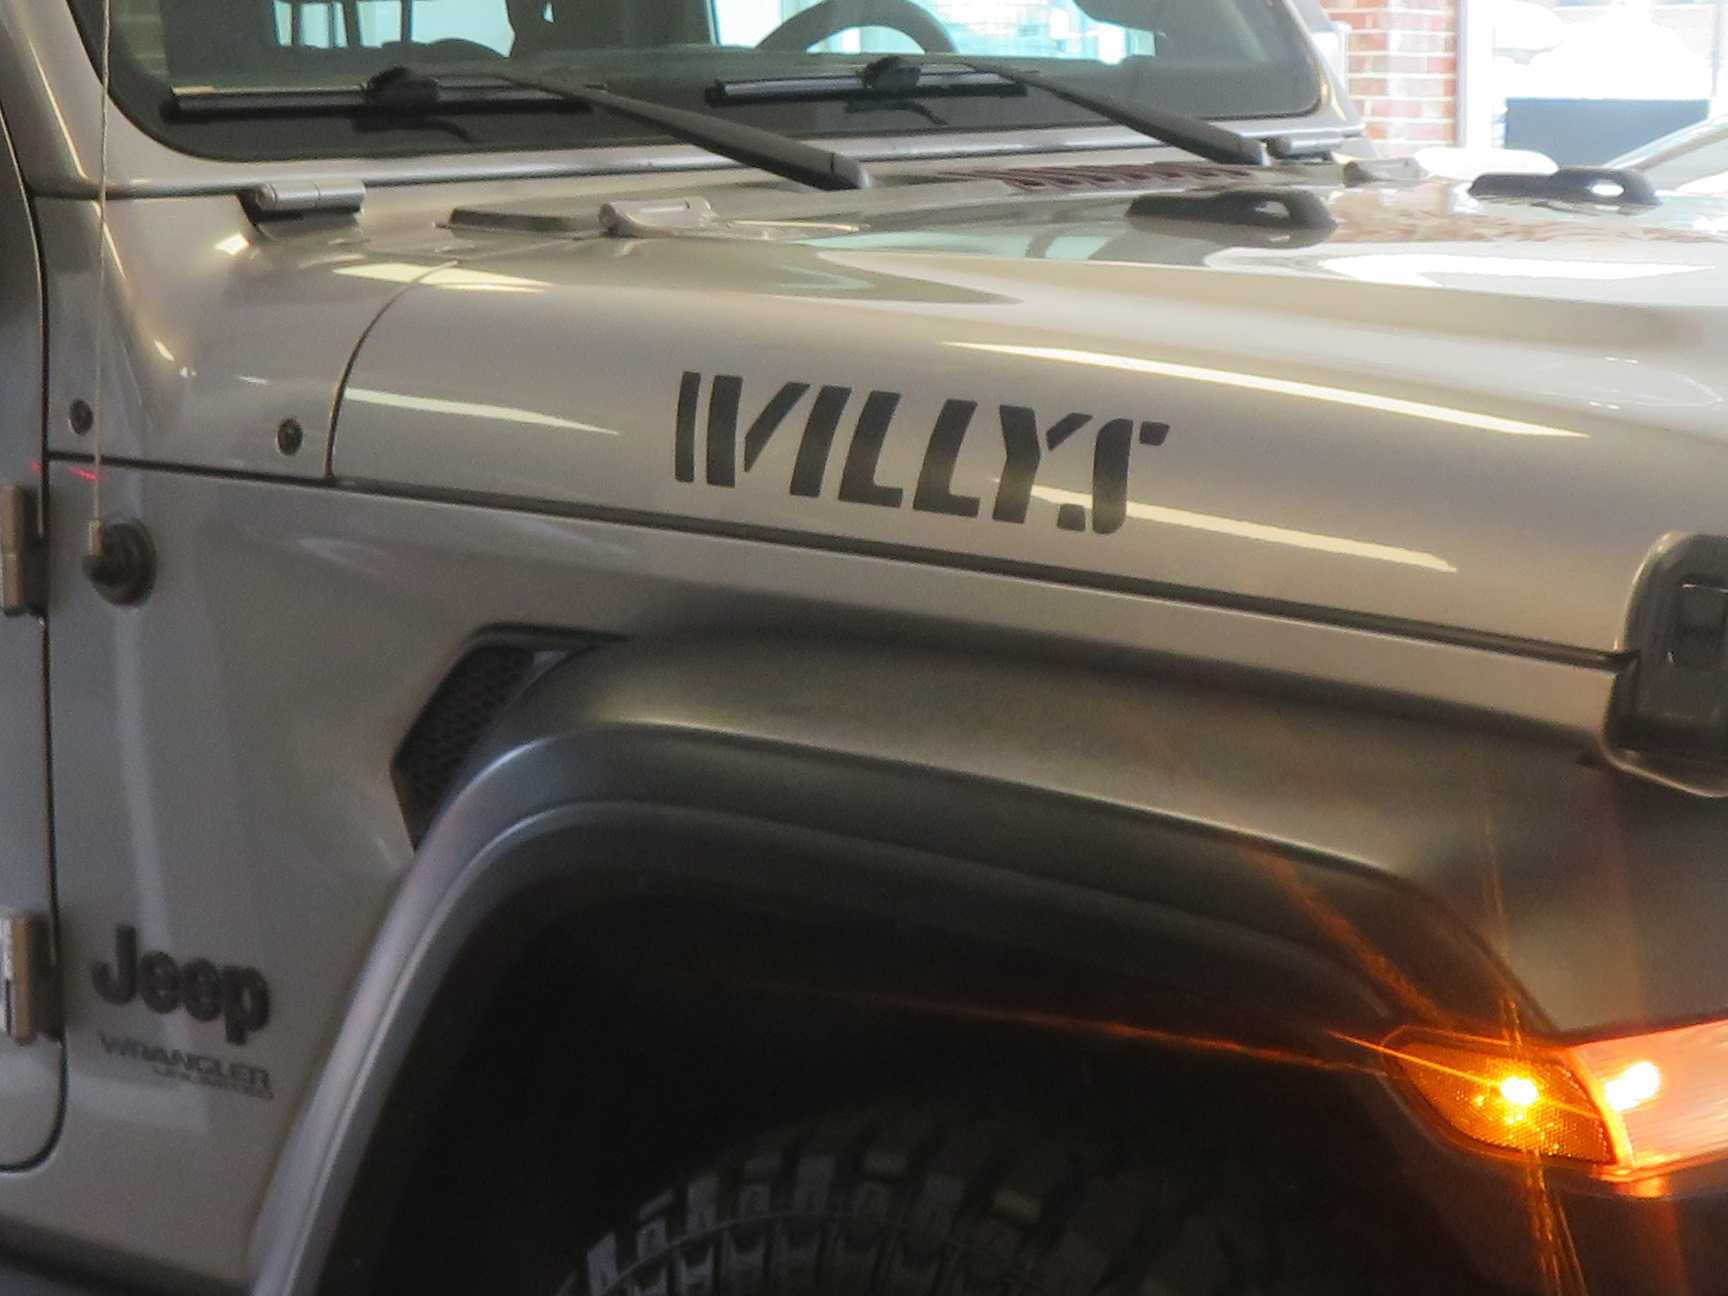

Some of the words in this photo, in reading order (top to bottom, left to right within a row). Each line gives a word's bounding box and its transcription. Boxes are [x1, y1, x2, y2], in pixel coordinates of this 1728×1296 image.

[675, 371, 1171, 535] WILLYS
[92, 924, 271, 1045] Jeep
[97, 1029, 272, 1088] WRANGLER
